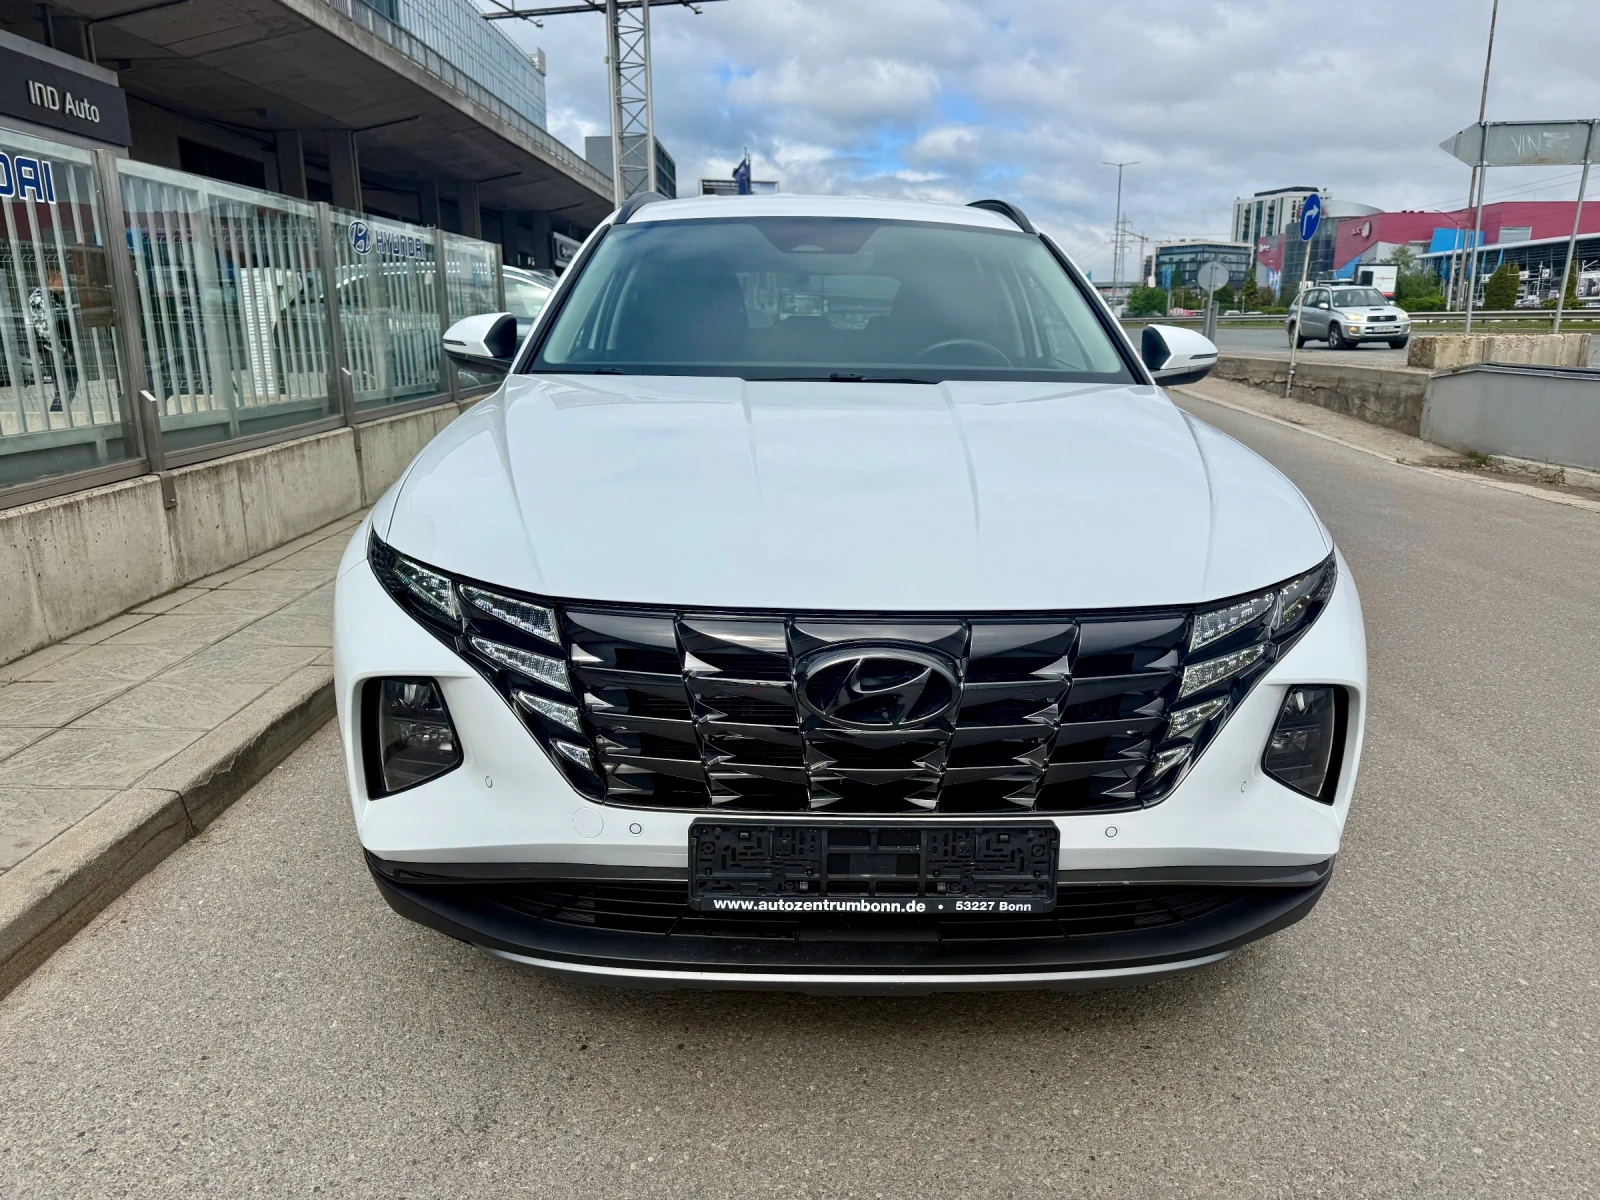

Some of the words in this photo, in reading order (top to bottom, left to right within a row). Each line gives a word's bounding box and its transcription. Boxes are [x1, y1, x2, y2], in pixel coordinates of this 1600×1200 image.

[27, 80, 60, 111] IND
[64, 91, 100, 123] Auto
[375, 229, 427, 261] HYUNDAI
[713, 899, 927, 913] www.autozentrumbonn.de
[955, 901, 996, 912] 53227
[998, 901, 1032, 912] Bonn
